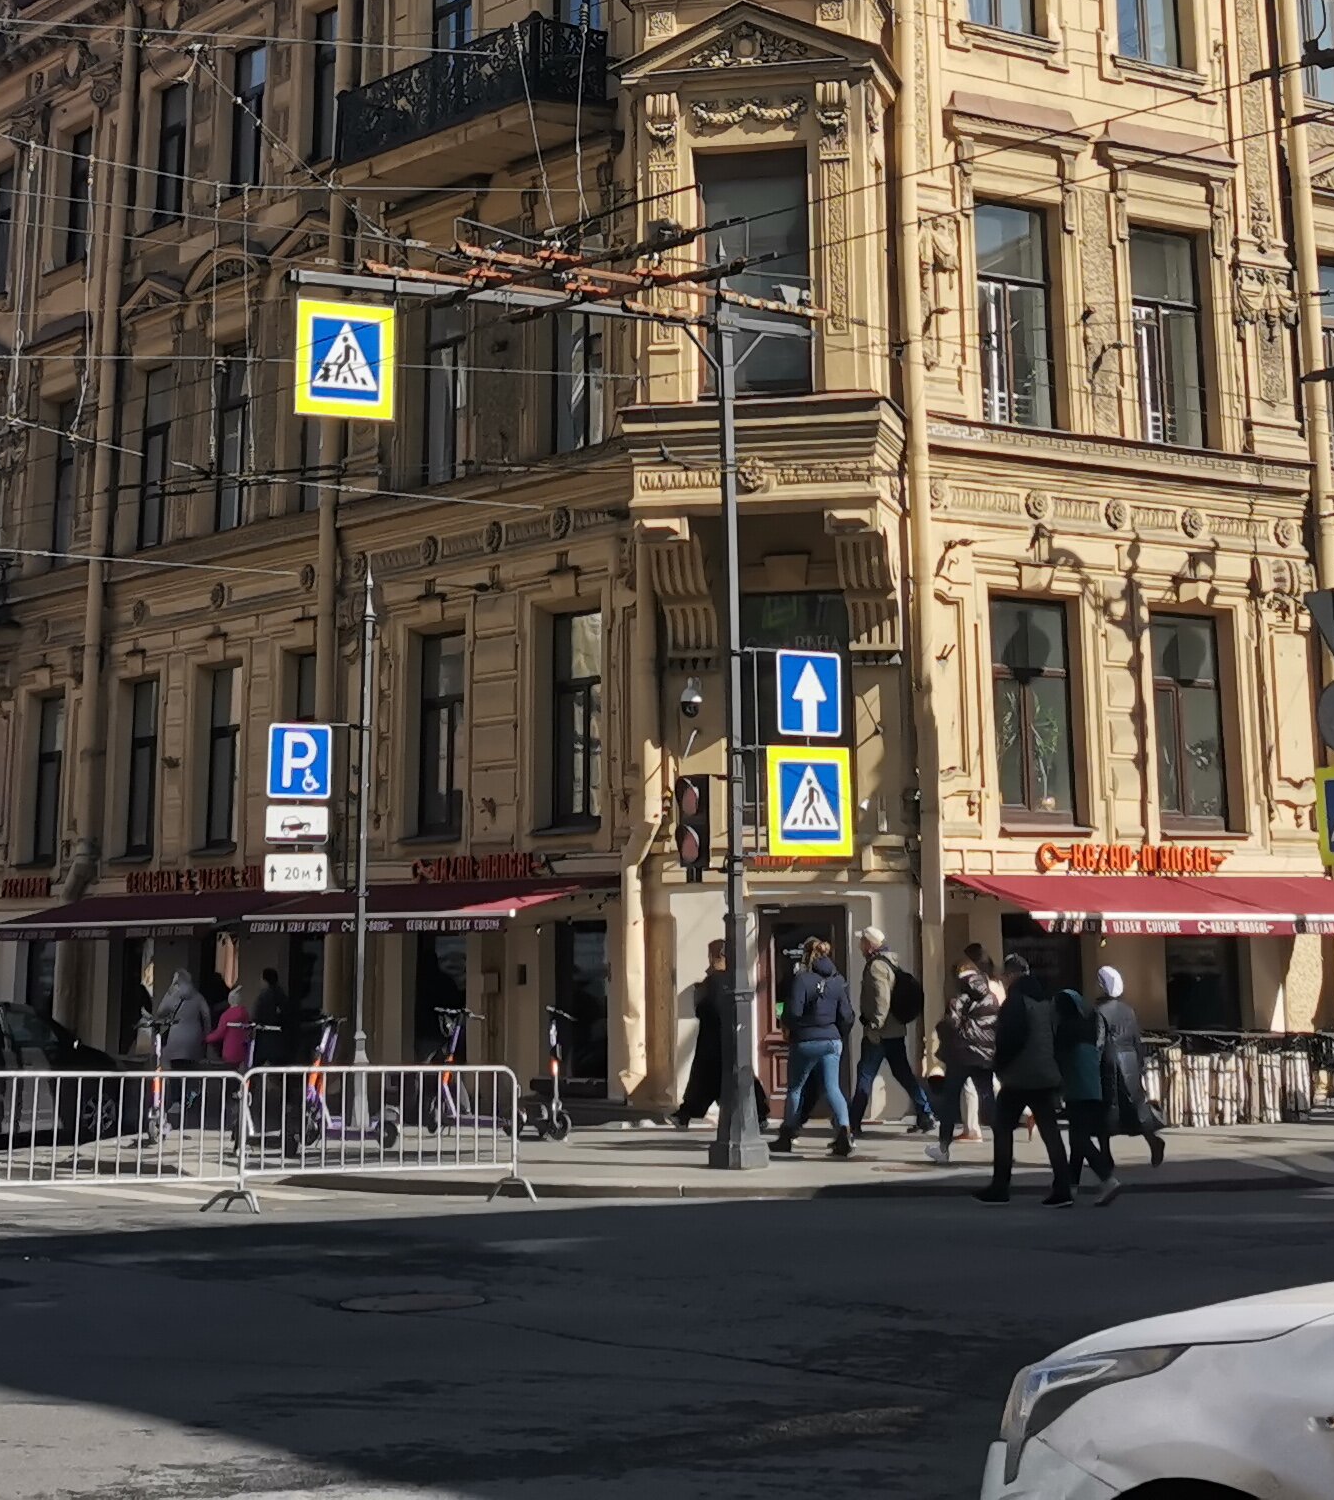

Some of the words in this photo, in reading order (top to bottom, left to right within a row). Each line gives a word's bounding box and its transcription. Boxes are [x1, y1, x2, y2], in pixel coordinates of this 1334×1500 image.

[282, 731, 317, 788] P
[1113, 920, 1142, 933] UZBEK
[1145, 920, 1182, 933] CUISINE
